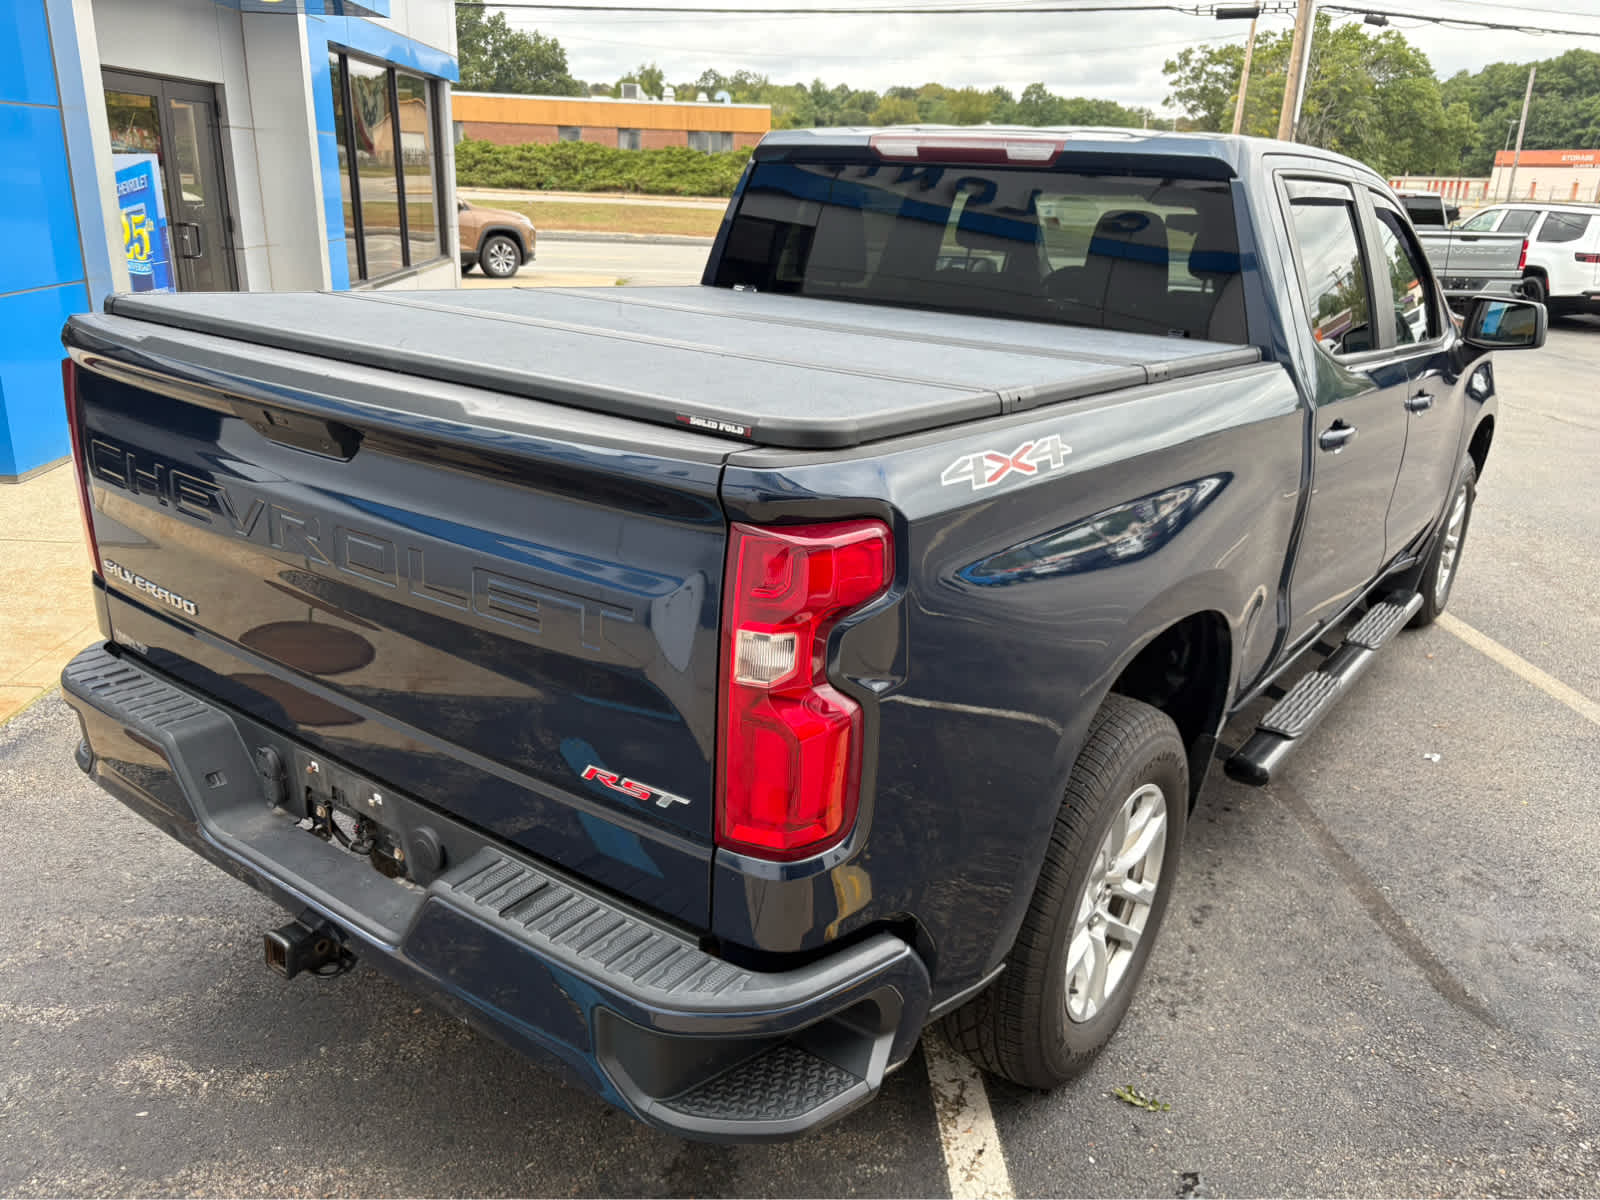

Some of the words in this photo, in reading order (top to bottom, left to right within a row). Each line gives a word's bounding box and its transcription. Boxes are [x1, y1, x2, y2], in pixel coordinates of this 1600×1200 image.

[689, 416, 718, 429] SOLID
[719, 423, 744, 435] FOLD
[91, 438, 635, 651] CHEVROLET
[103, 558, 198, 616] SILVERADO
[581, 764, 691, 808] RST
